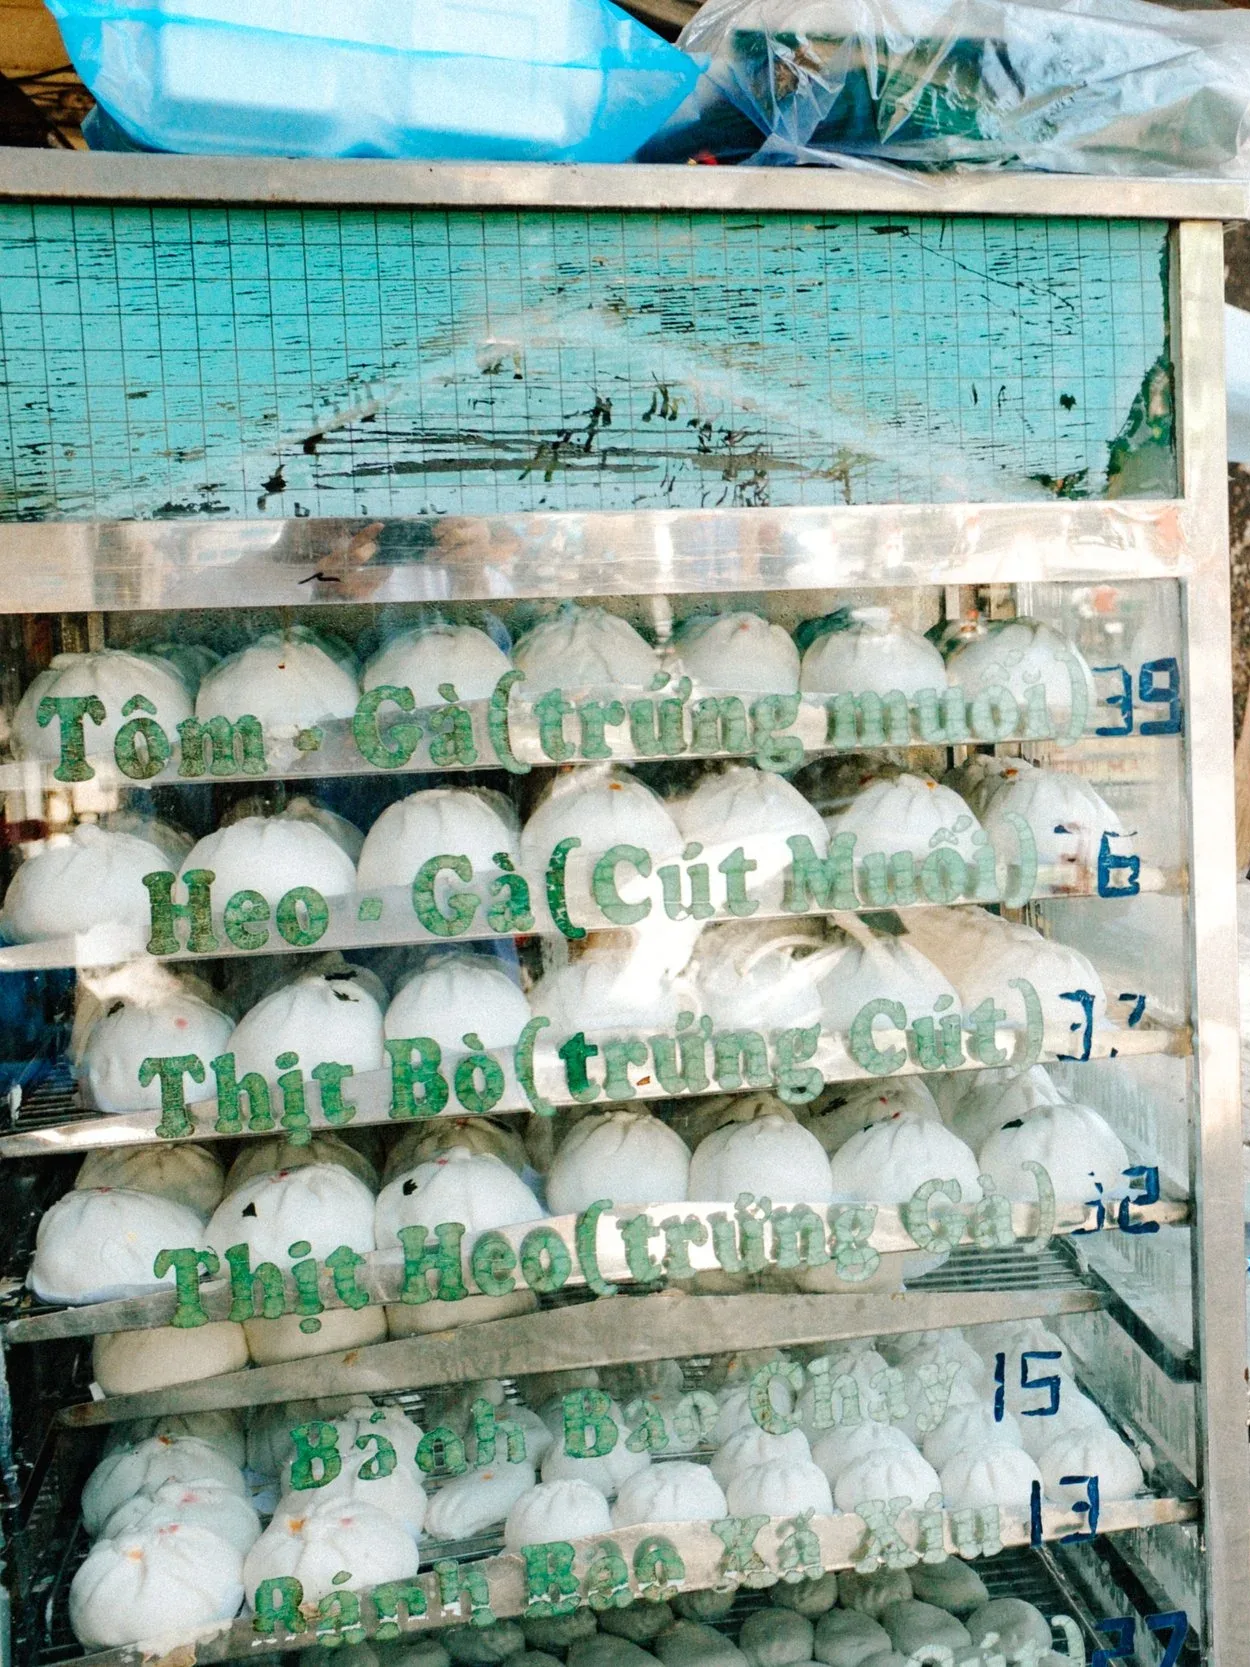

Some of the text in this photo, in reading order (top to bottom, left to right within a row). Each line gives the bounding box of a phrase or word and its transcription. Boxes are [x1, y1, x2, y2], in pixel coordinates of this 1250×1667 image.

[1091, 656, 1181, 737] 39
[36, 693, 268, 783] Tôm
[142, 868, 330, 956] Heo
[138, 1050, 356, 1145] Thịt
[850, 978, 1044, 1075] Cút)
[153, 1240, 370, 1334] Thịt
[562, 1387, 720, 1459] Bao
[994, 1351, 1062, 1422] 15
[1031, 1476, 1100, 1546] 13
[1092, 1610, 1188, 1667] 27
